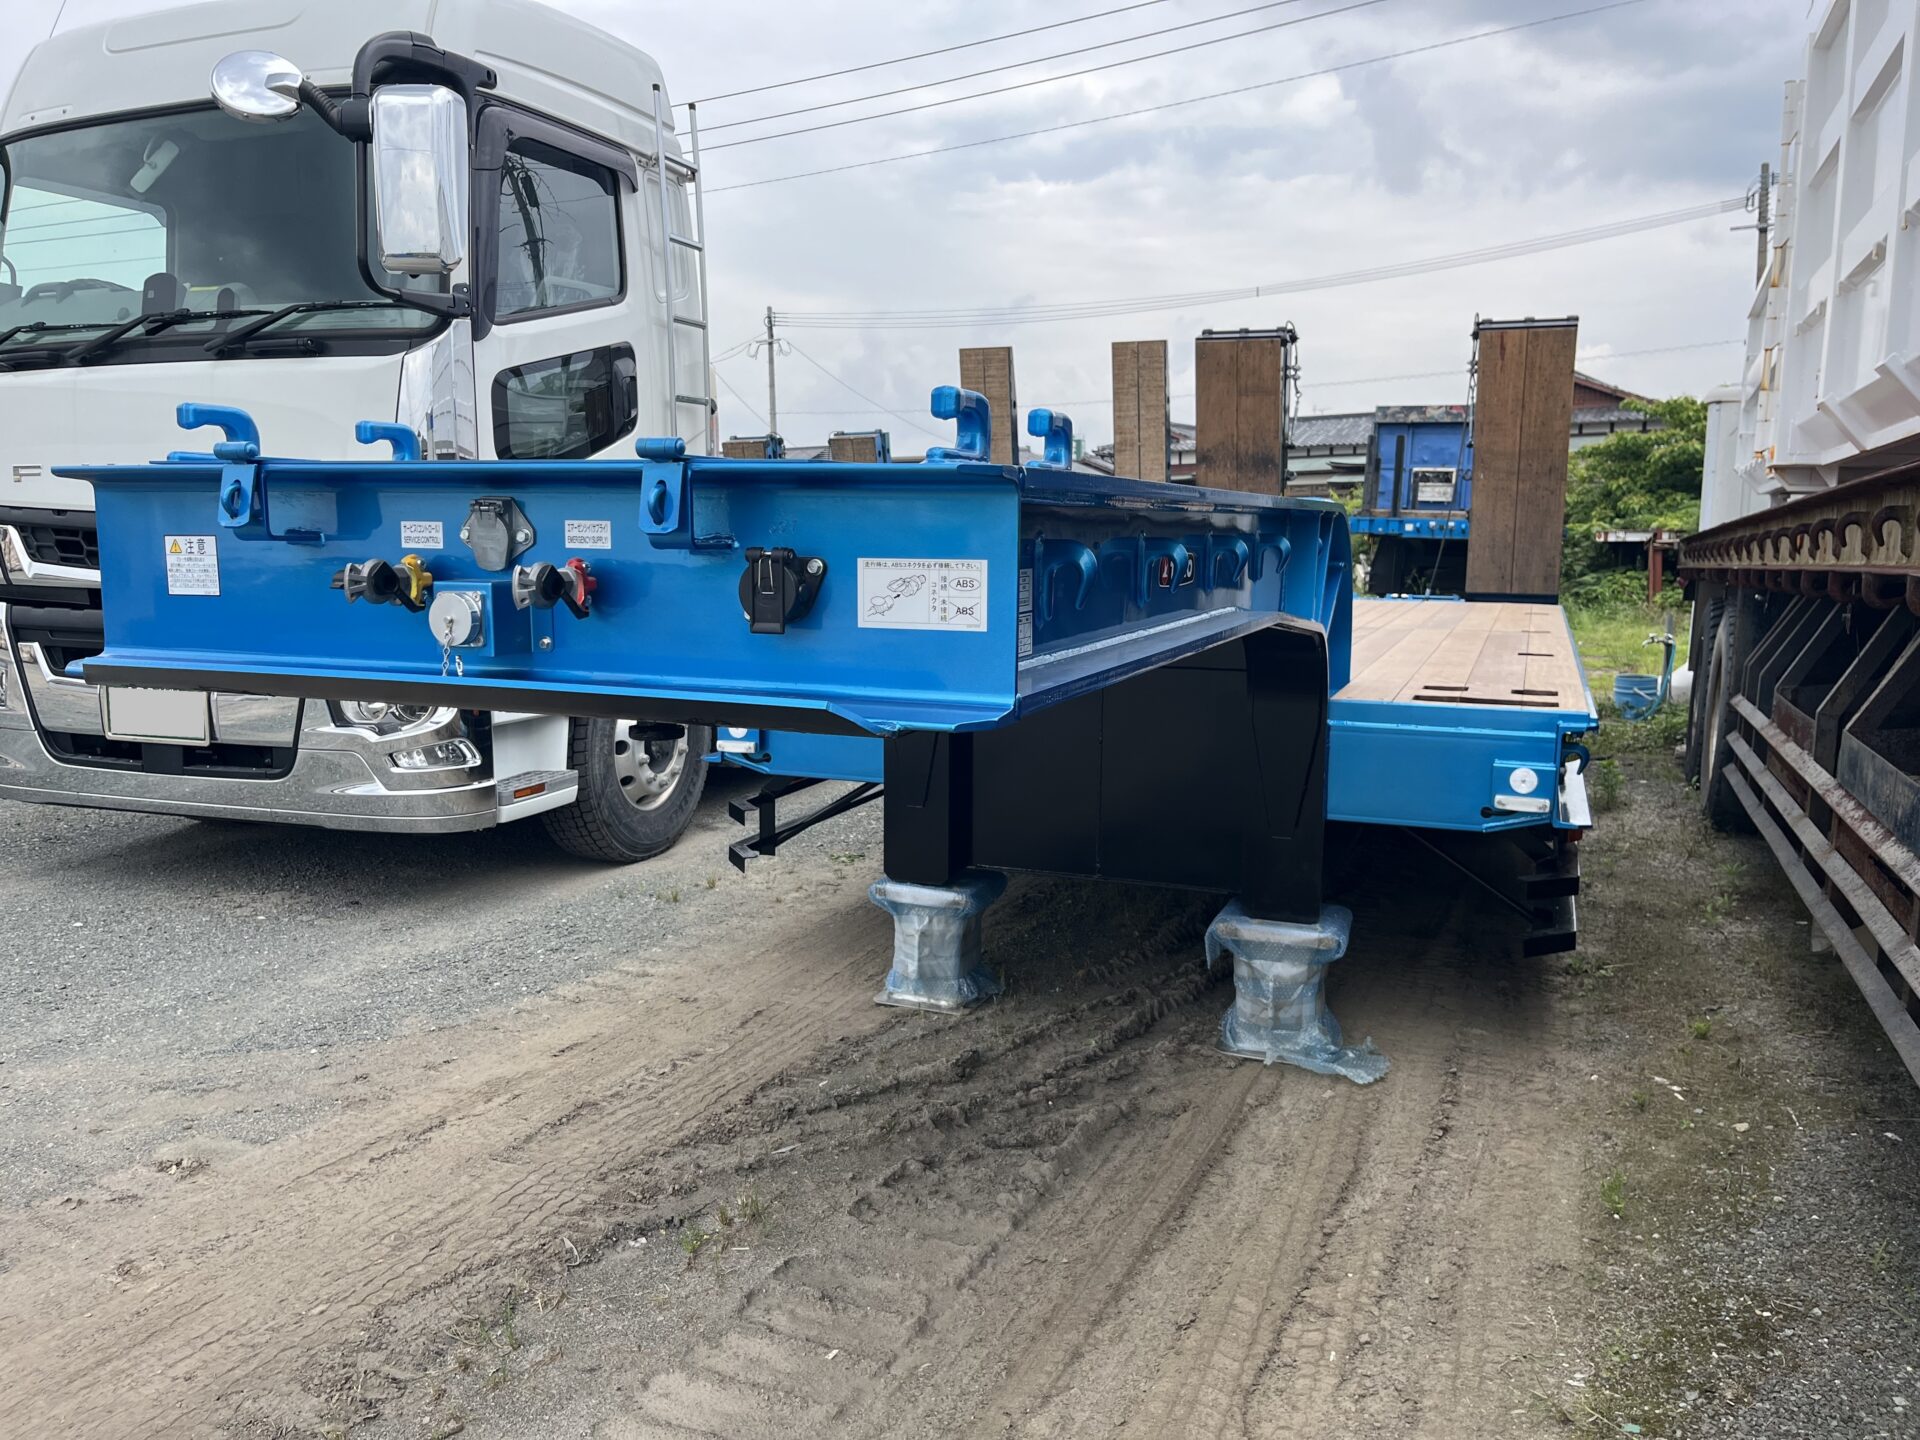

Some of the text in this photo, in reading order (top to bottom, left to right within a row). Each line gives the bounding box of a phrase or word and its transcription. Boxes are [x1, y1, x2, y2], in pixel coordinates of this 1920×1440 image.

[12, 464, 42, 482] F
[184, 538, 206, 555] 注意
[955, 579, 975, 589] ABS
[930, 582, 938, 613] コネクタ
[955, 606, 975, 616] ABS
